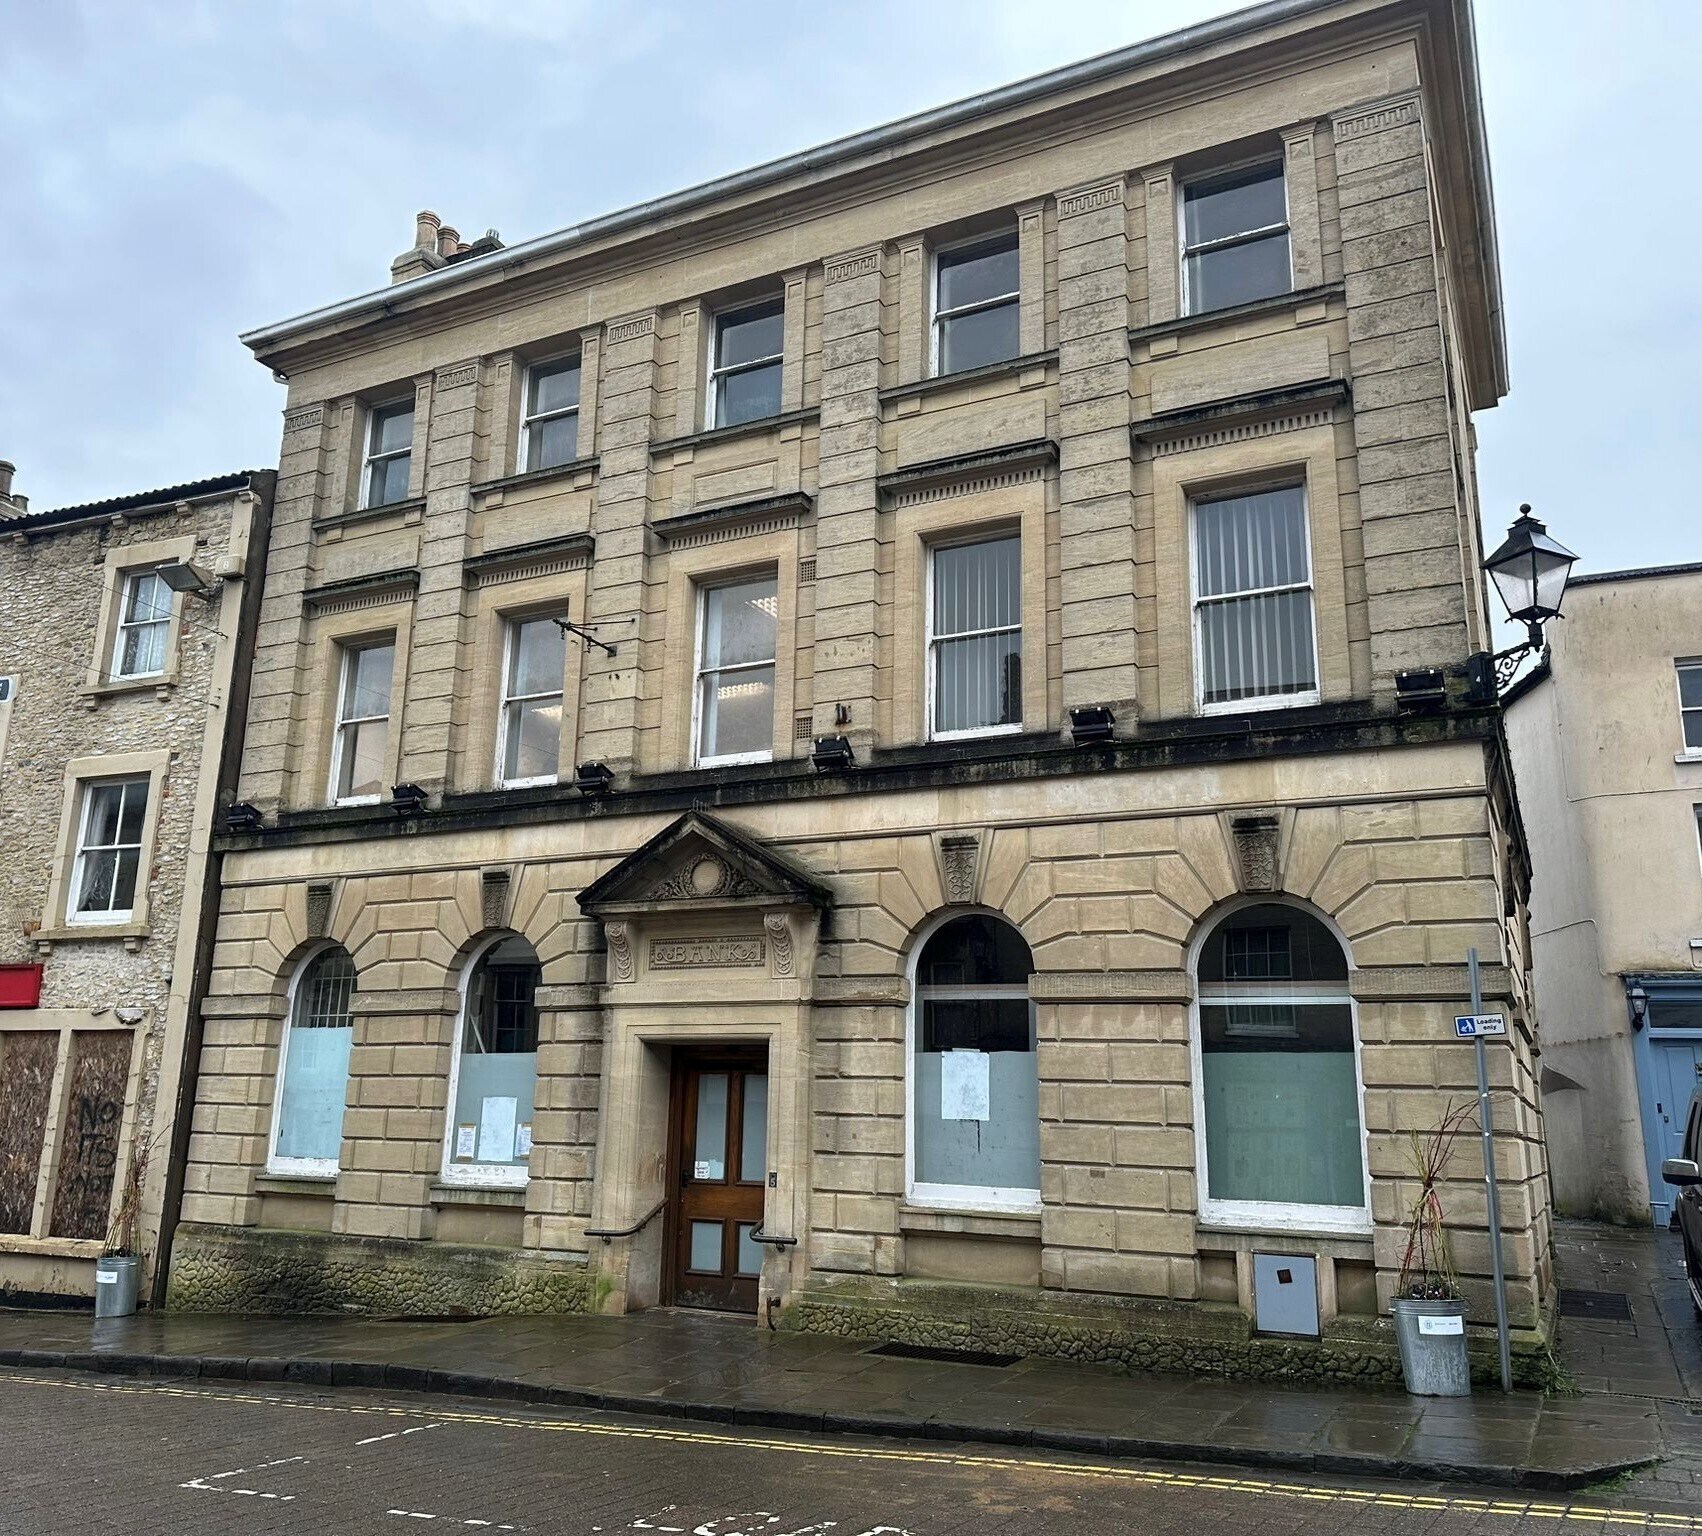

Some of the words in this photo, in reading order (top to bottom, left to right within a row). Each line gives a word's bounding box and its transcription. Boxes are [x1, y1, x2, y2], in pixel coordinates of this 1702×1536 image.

[672, 943, 743, 963] BANK
[1476, 1017, 1502, 1025] Loading
[79, 1096, 118, 1131] NO
